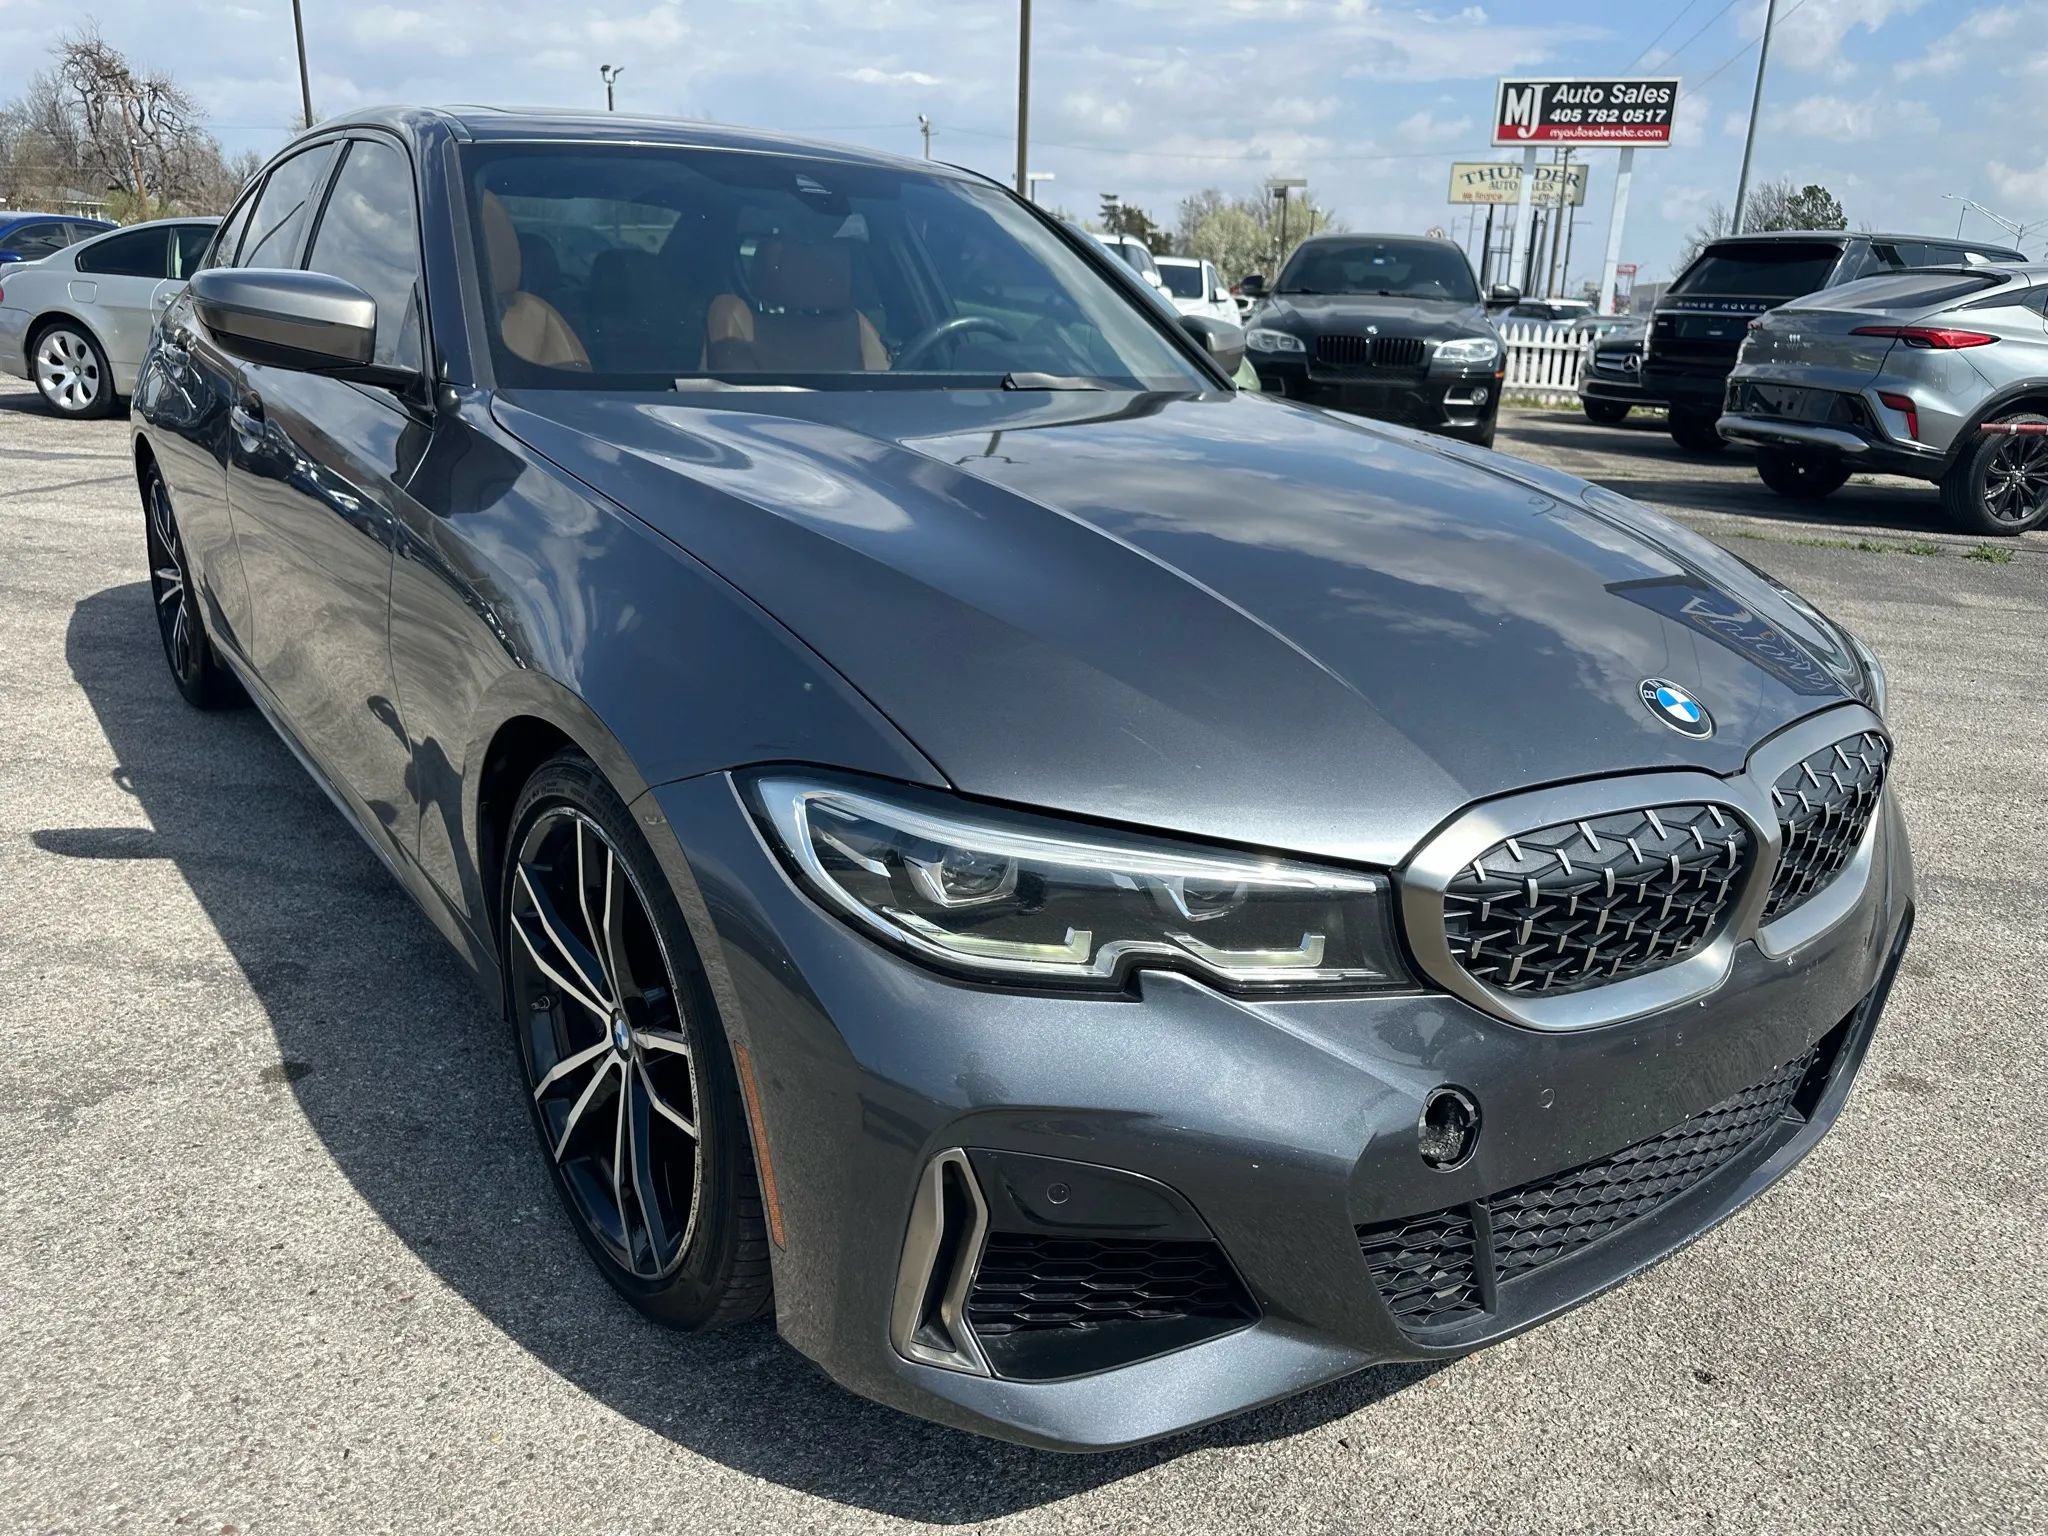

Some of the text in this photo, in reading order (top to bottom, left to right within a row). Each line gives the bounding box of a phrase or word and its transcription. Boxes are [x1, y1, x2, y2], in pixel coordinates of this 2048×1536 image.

[1552, 84, 1671, 104] Auto Sales
[1504, 84, 1550, 138] MJ
[1550, 109, 1667, 123] 405 782 0517
[1550, 126, 1663, 141] mjautosalesokc.com
[1489, 181, 1518, 191] AUTO
[1721, 303, 1767, 311] ROVER
